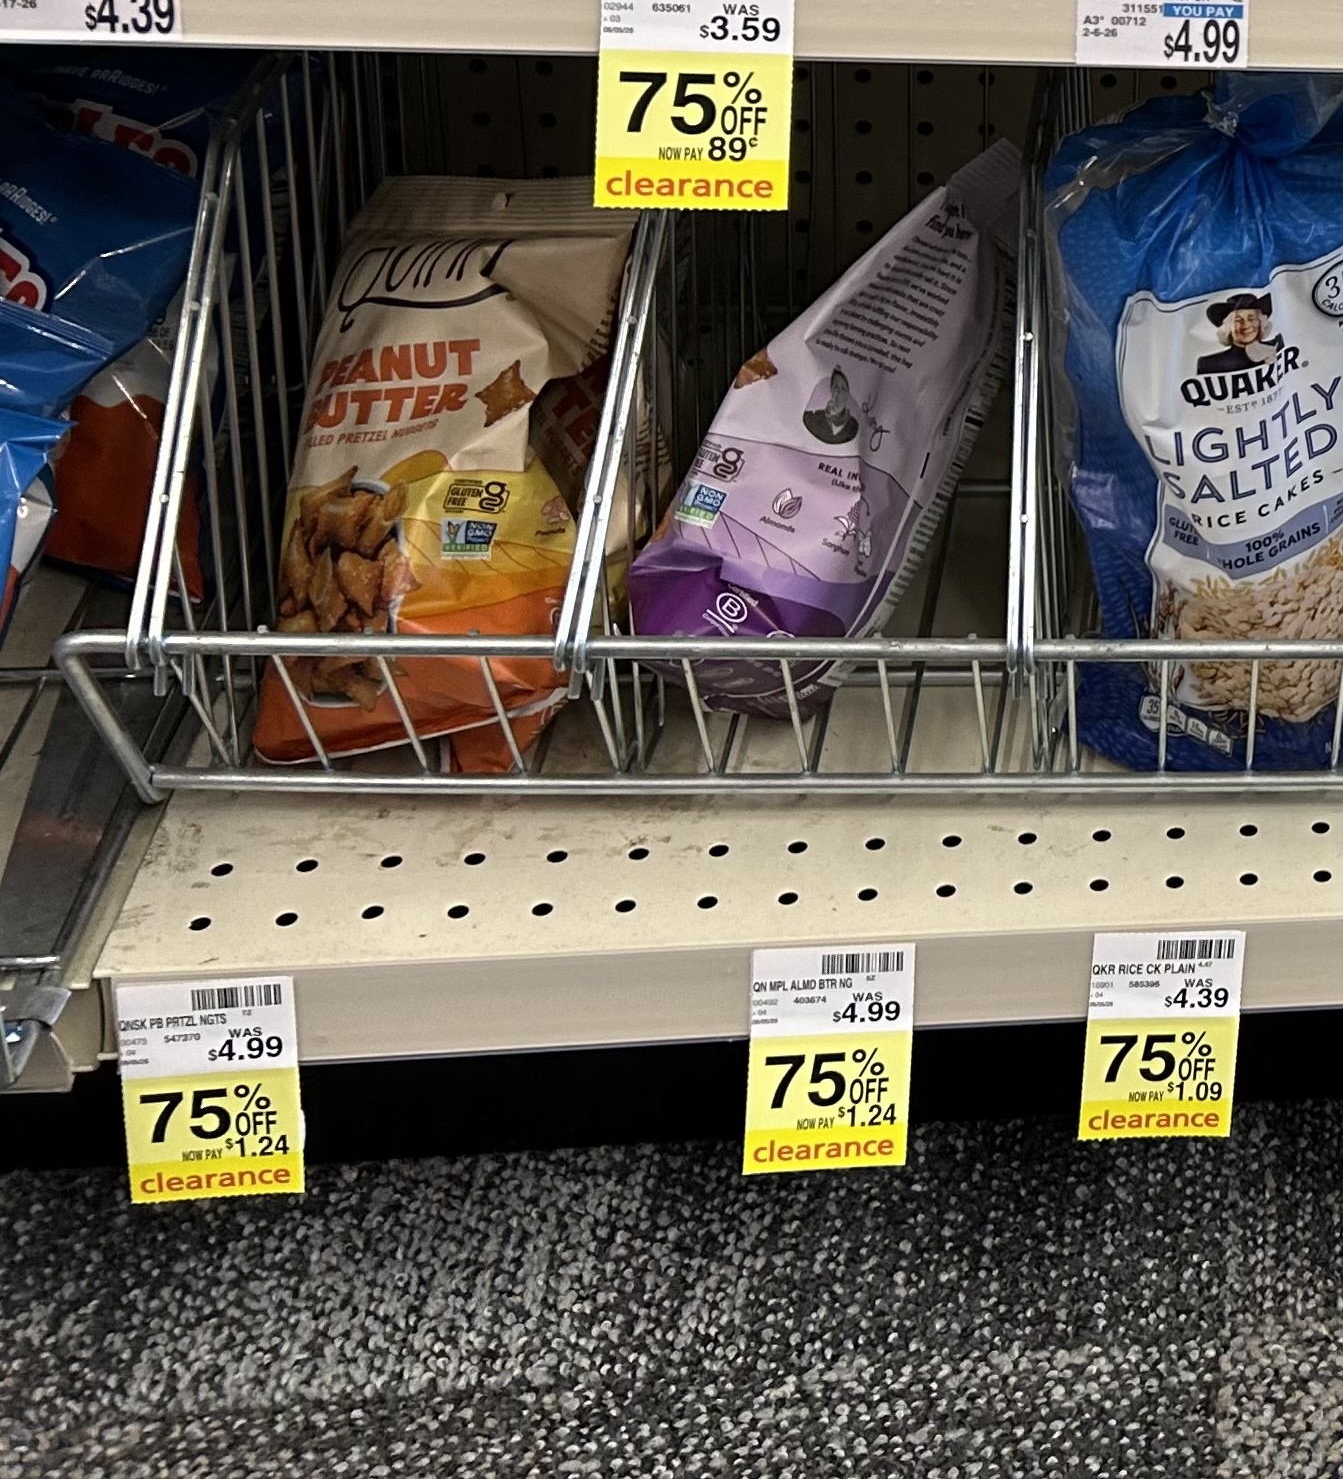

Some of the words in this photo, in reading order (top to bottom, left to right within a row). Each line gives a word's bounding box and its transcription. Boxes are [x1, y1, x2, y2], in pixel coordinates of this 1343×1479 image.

[700, 15, 781, 41] $3.59
[1164, 19, 1240, 63] $4.99
[659, 147, 682, 161] NOW
[684, 147, 703, 162] PAY
[708, 136, 758, 162] 89¢
[606, 170, 773, 199] clearance
[314, 338, 482, 390] PEANUT
[1180, 345, 1301, 408] QUAKER
[1144, 376, 1343, 466] LIGHTLY
[818, 462, 843, 477] REAL
[1163, 423, 1339, 505] SALTED
[699, 486, 723, 500] NON
[1173, 531, 1199, 546] FREE
[1245, 531, 1285, 551] 100%
[1092, 964, 1115, 976] QKR
[1118, 964, 1143, 975] RICE
[1146, 964, 1161, 974] CK
[1165, 963, 1195, 974] PLAIN
[753, 981, 767, 992] QN
[769, 980, 788, 992] MPL
[791, 980, 817, 991] ALMD
[819, 979, 838, 990] BTR
[840, 978, 852, 989] NG
[1165, 988, 1229, 1008] $4.39
[833, 1001, 900, 1023] $4.99
[228, 1027, 263, 1038] WAS
[208, 1036, 283, 1061] $4.99
[1168, 1082, 1222, 1101] $1.09
[225, 1135, 289, 1158] $1.24
[753, 1138, 894, 1163] clearance
[140, 1168, 290, 1194] clearance
